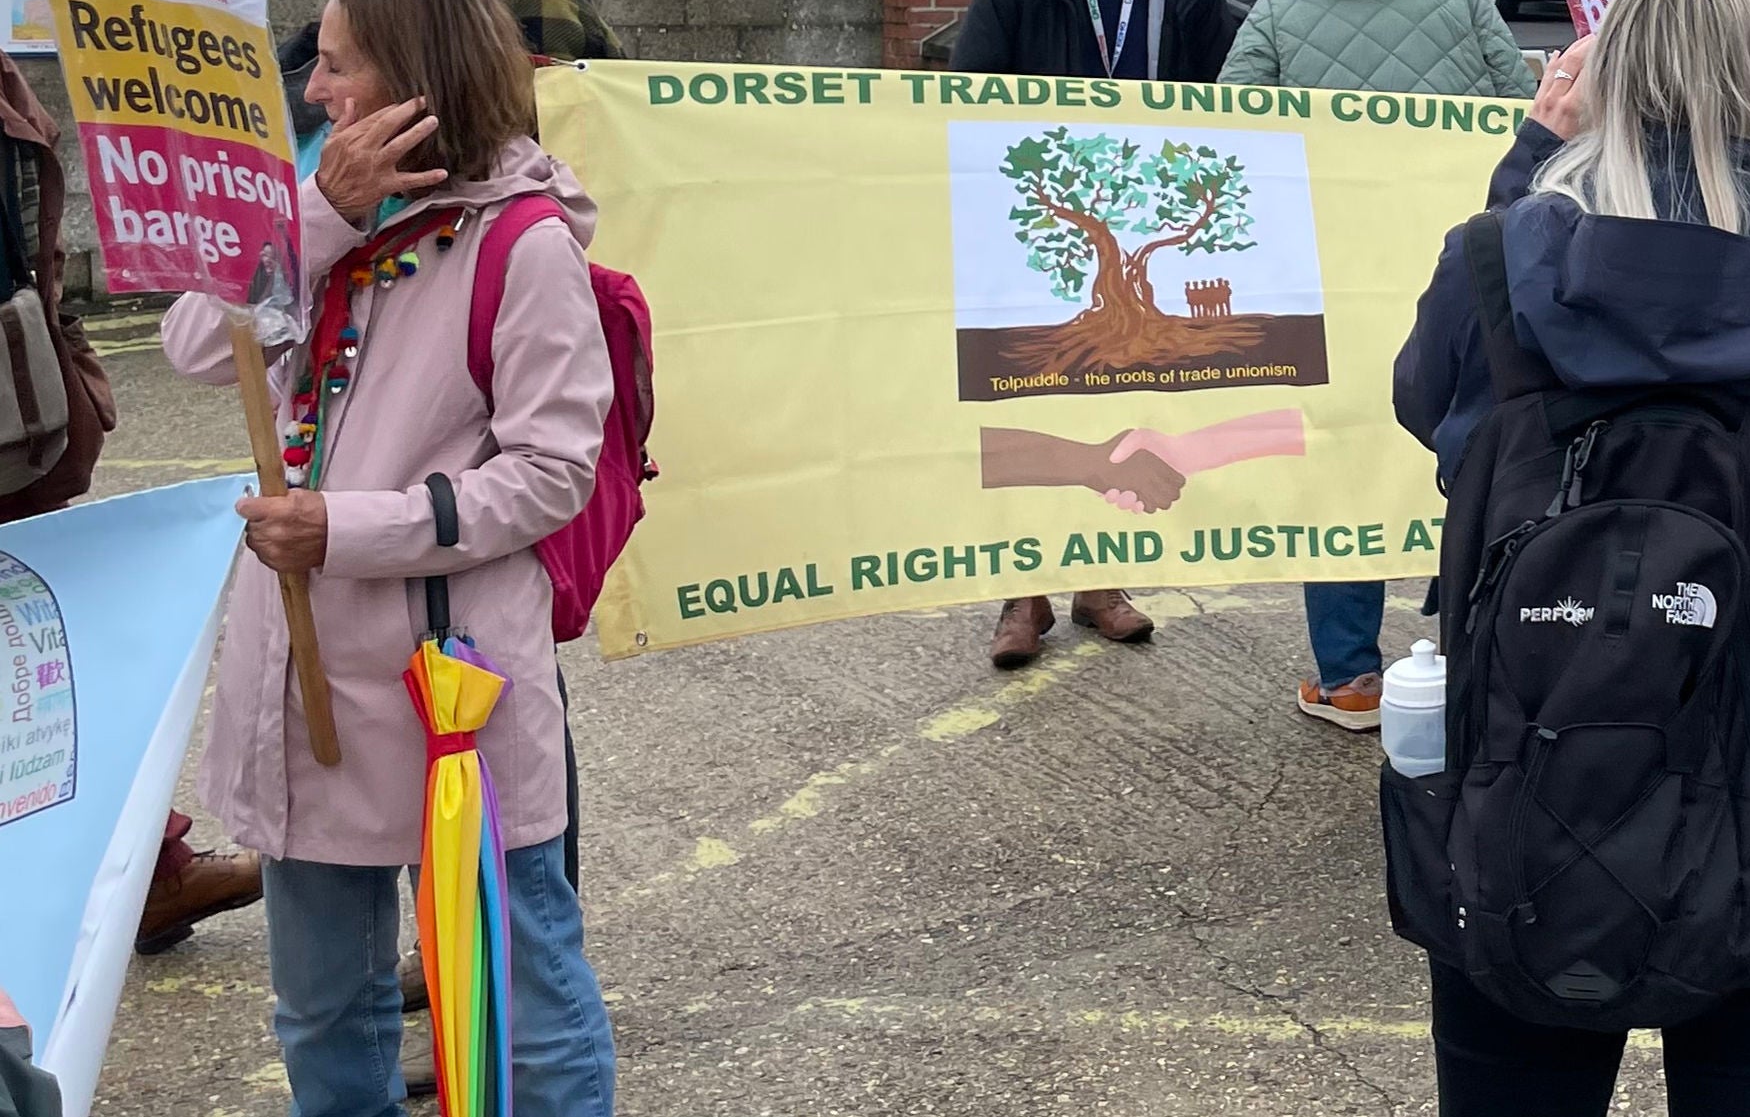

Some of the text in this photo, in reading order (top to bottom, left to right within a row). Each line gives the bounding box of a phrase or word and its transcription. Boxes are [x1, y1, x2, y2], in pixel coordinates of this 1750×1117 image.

[68, 0, 261, 79] Refugees
[83, 67, 268, 138] welcome
[648, 72, 1525, 136] DORSET TRADES UNION COUNCI
[97, 135, 293, 221] No prison
[109, 196, 241, 264] barge
[990, 373, 1069, 393] Tolpuddle
[1085, 372, 1110, 386] the
[1115, 369, 1155, 384] roots
[1159, 367, 1175, 383] of
[1179, 366, 1222, 382] trade
[1226, 362, 1298, 380] unionism
[677, 563, 834, 620] EQUAL
[851, 537, 1043, 591] RIGHTS
[1060, 530, 1164, 567] AND
[1179, 523, 1386, 564] JUSTICE
[1652, 594, 1696, 610] NORTH
[1676, 582, 1699, 596] THE
[1666, 609, 1695, 624] FACE
